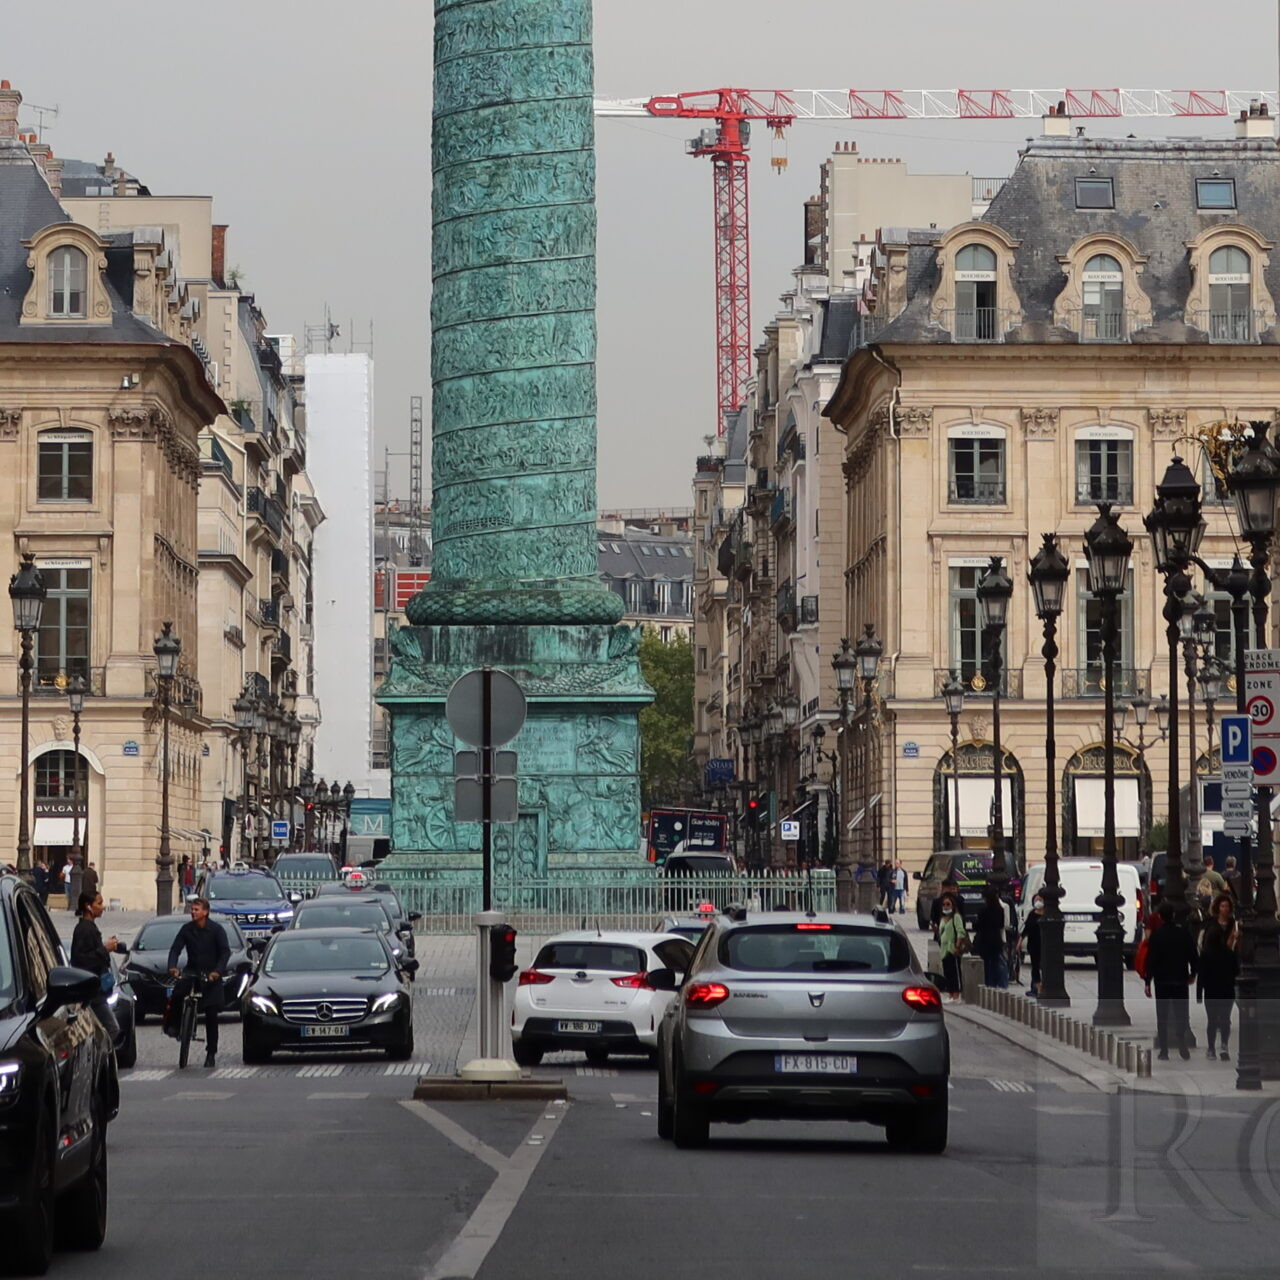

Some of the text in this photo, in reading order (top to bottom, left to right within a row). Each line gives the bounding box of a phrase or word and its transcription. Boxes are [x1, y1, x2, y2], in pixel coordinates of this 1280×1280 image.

[1247, 680, 1273, 689] ZONE
[1252, 704, 1269, 717] 30
[1228, 725, 1242, 756] P
